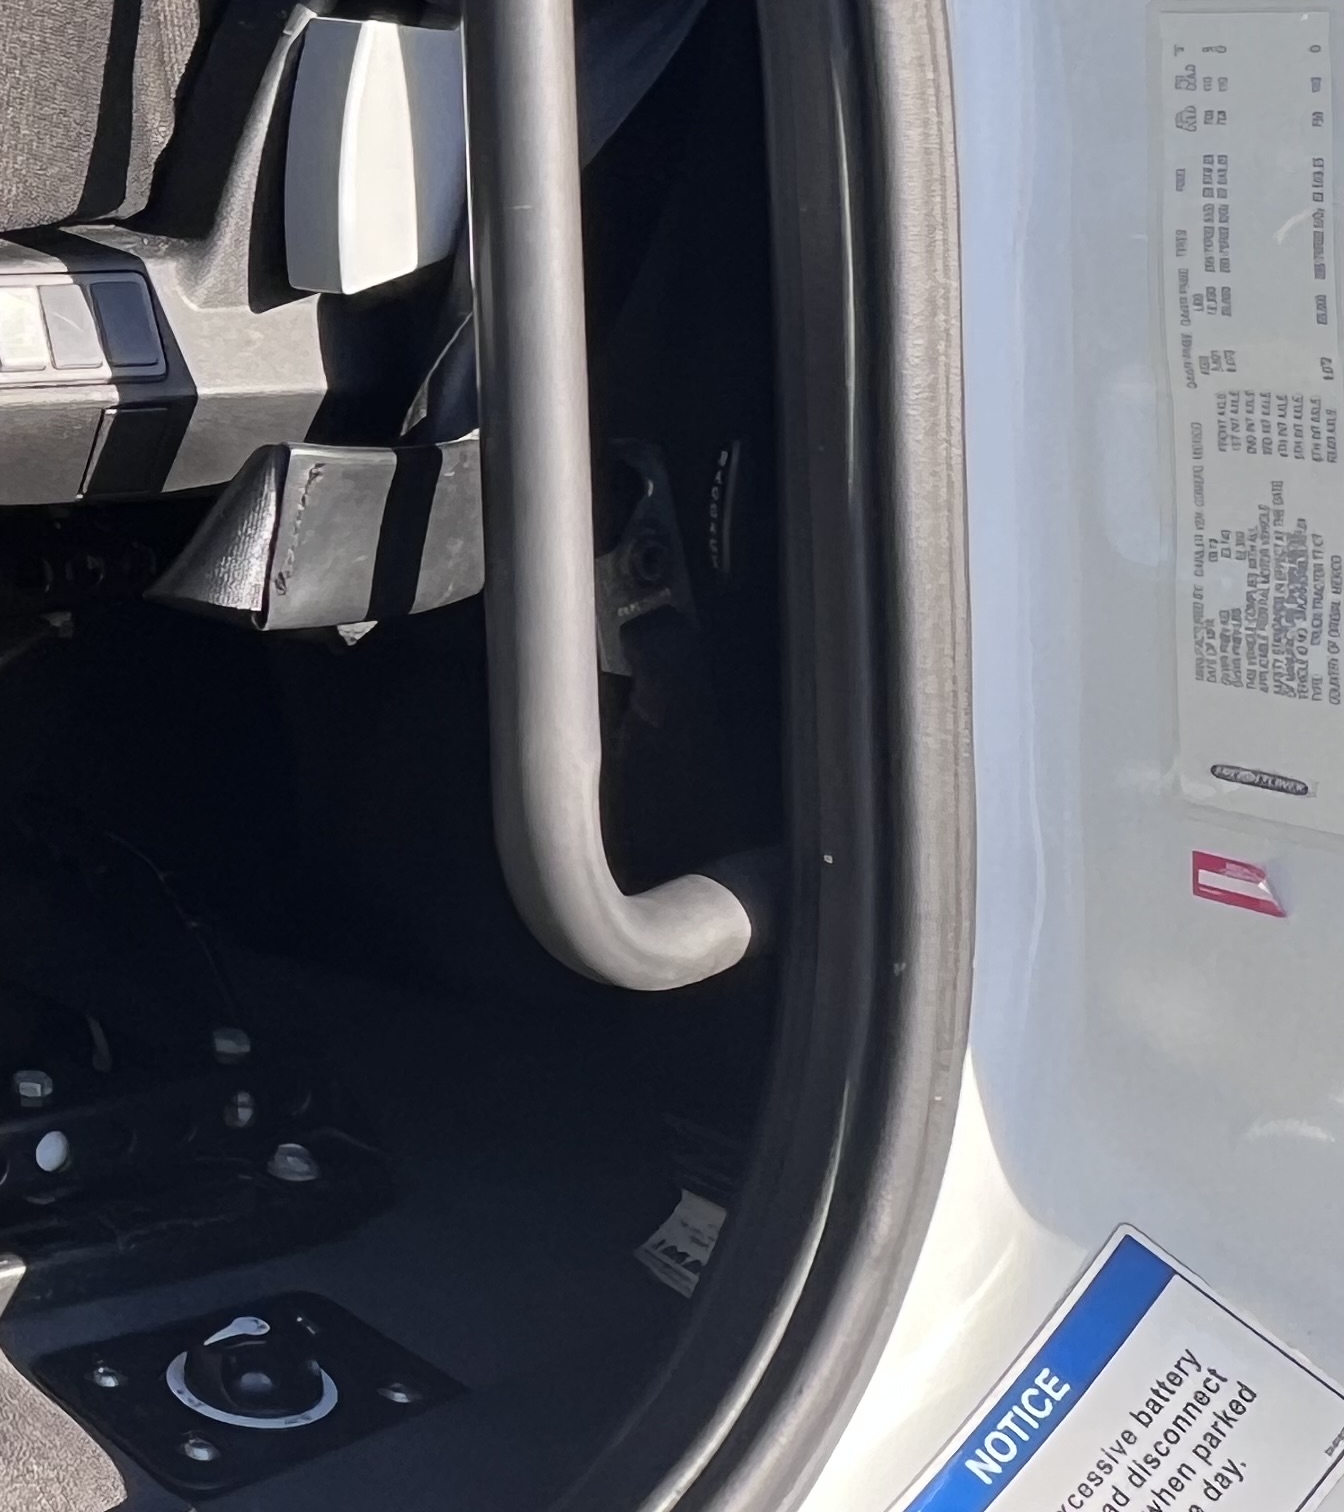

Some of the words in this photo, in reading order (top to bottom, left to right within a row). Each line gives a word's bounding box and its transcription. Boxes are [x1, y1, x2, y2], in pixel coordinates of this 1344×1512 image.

[964, 1366, 1072, 1486] NOTICE
[1127, 1366, 1229, 1489] disconnect
[1129, 1348, 1202, 1428] battery
[1192, 1380, 1258, 1467] parked
[1203, 1458, 1248, 1502] day.
